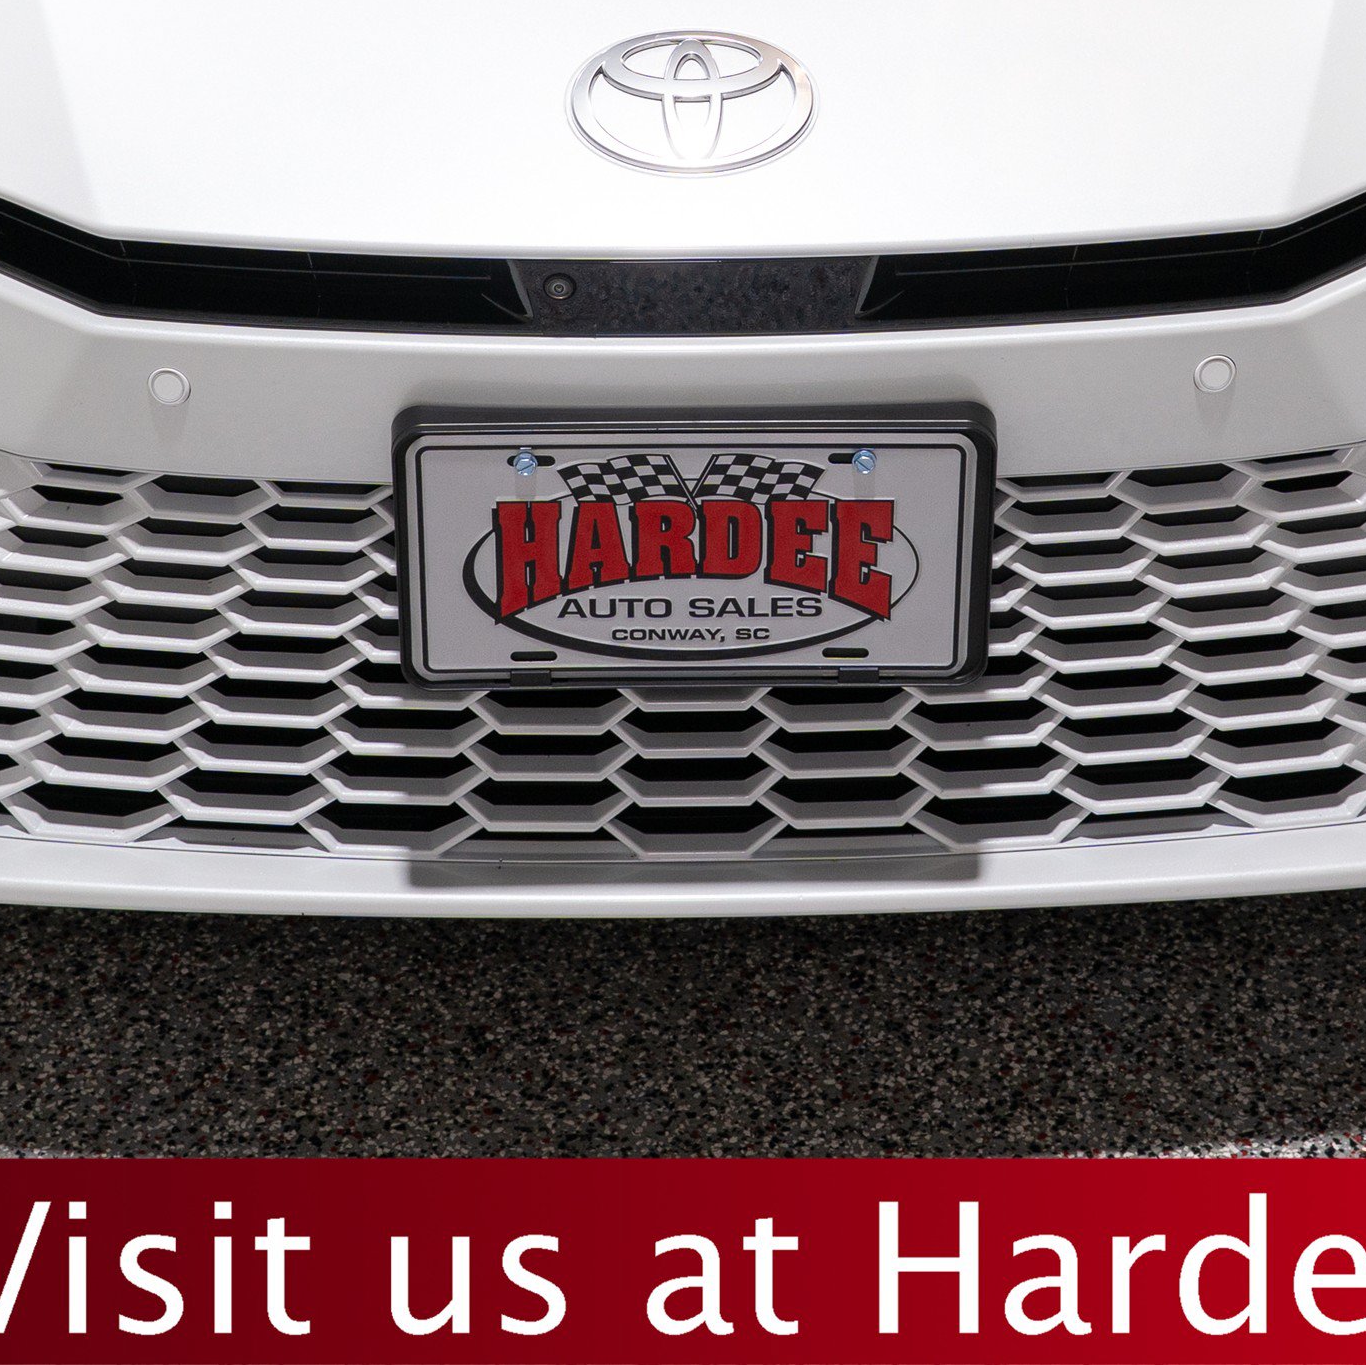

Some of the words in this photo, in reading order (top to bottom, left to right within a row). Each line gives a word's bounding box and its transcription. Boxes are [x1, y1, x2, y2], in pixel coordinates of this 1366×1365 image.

[494, 500, 894, 622] HARDEE
[557, 598, 672, 619] AUTO
[688, 596, 822, 618] SALES
[611, 628, 725, 642] CONWAY,
[735, 627, 770, 641] SC
